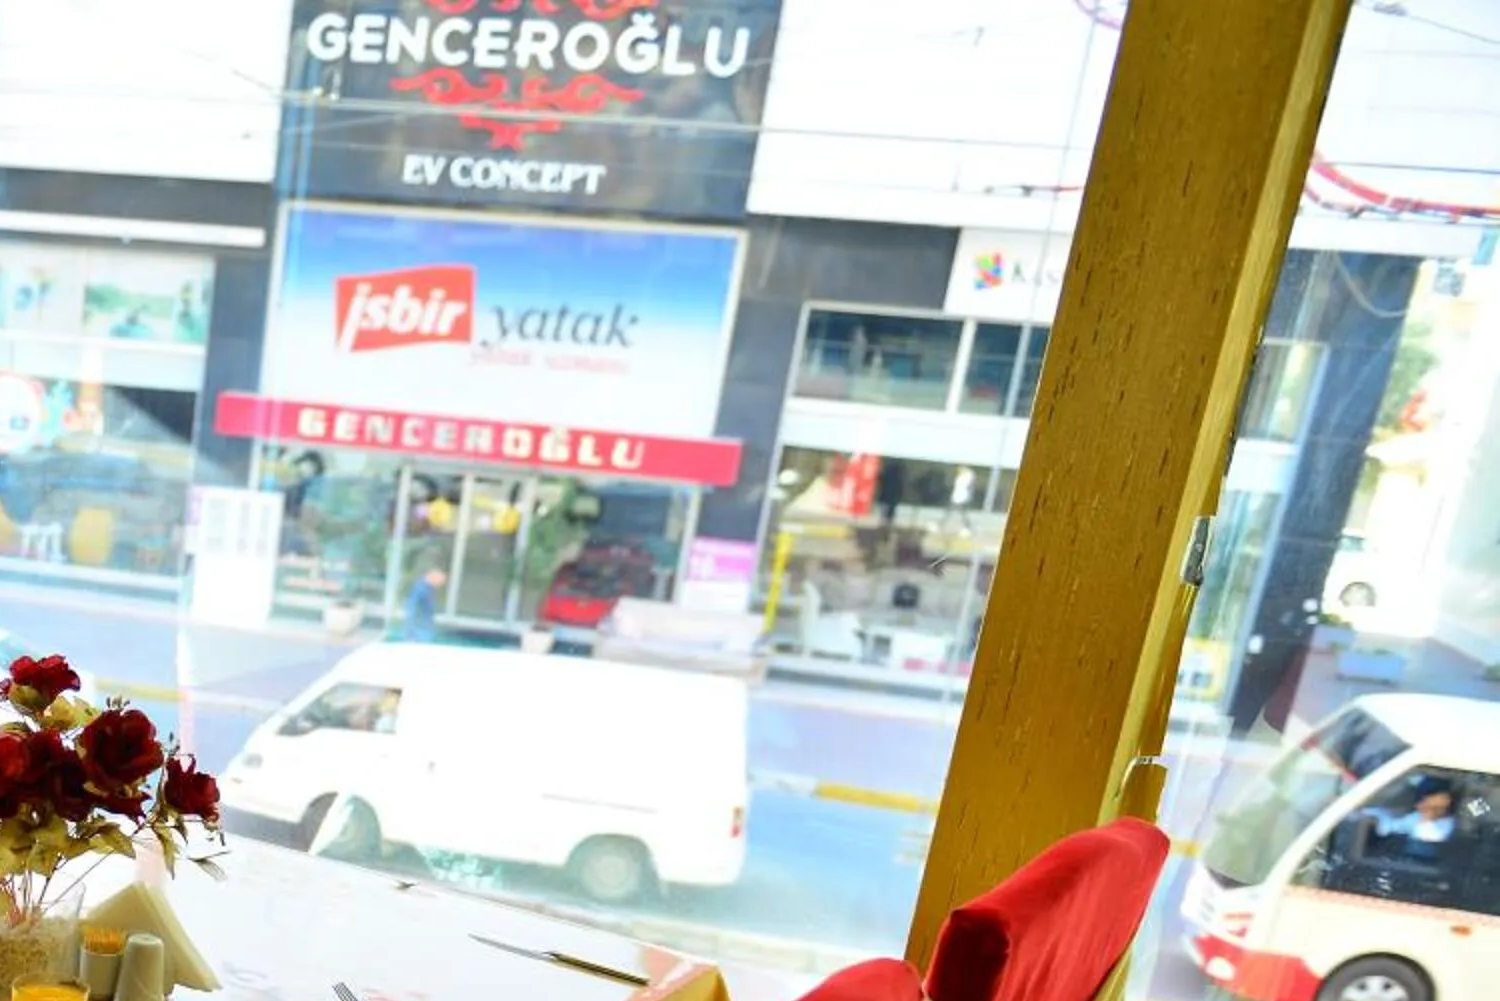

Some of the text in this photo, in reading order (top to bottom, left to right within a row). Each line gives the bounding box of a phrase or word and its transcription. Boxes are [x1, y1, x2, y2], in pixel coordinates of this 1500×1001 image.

[306, 15, 750, 78] GENCEROĞLU
[402, 154, 607, 195] EV CONCEPT
[299, 406, 646, 470] GENCEROĞLU
